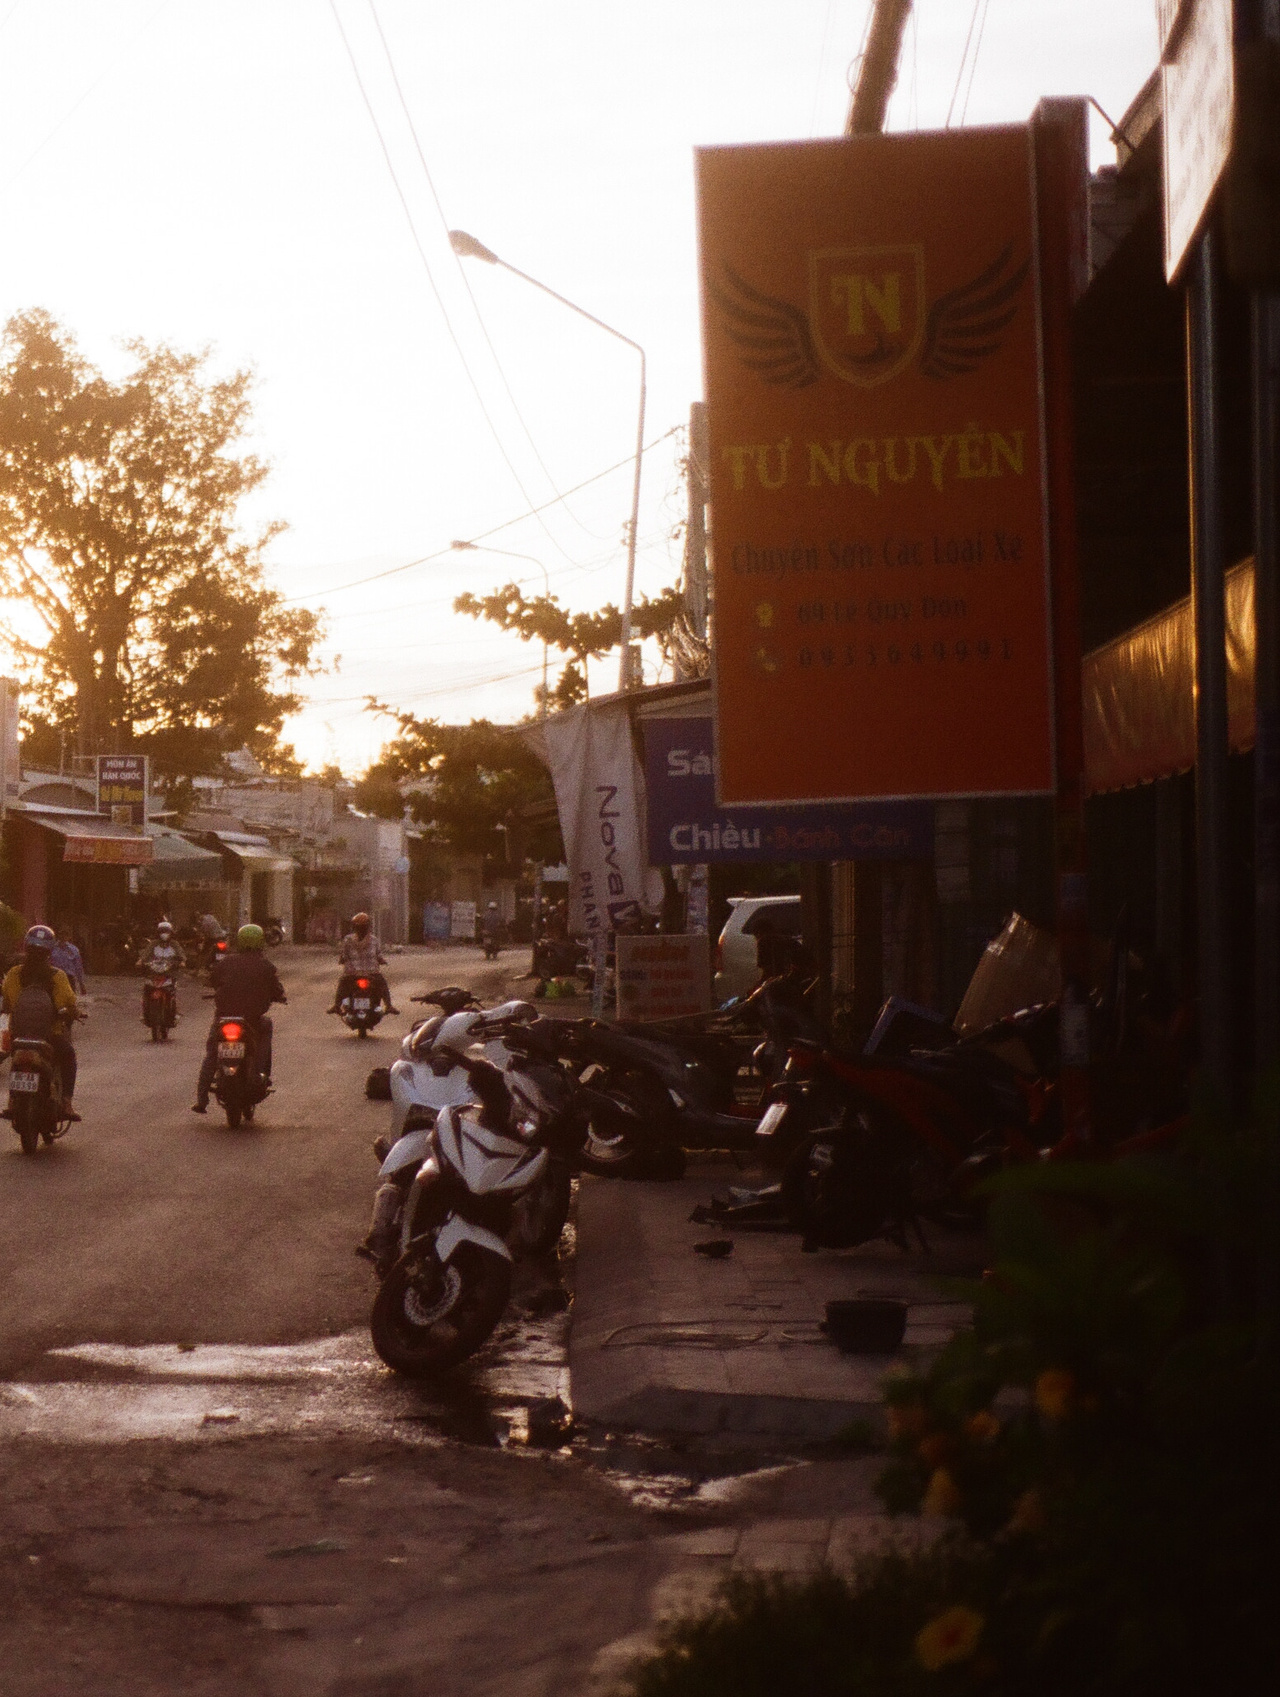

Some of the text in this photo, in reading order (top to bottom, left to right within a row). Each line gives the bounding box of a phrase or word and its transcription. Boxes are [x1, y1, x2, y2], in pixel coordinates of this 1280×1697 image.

[730, 538, 820, 581] Chuyên
[993, 531, 1024, 565] Xe
[667, 749, 713, 777] Sá
[668, 819, 761, 851] Chiều
